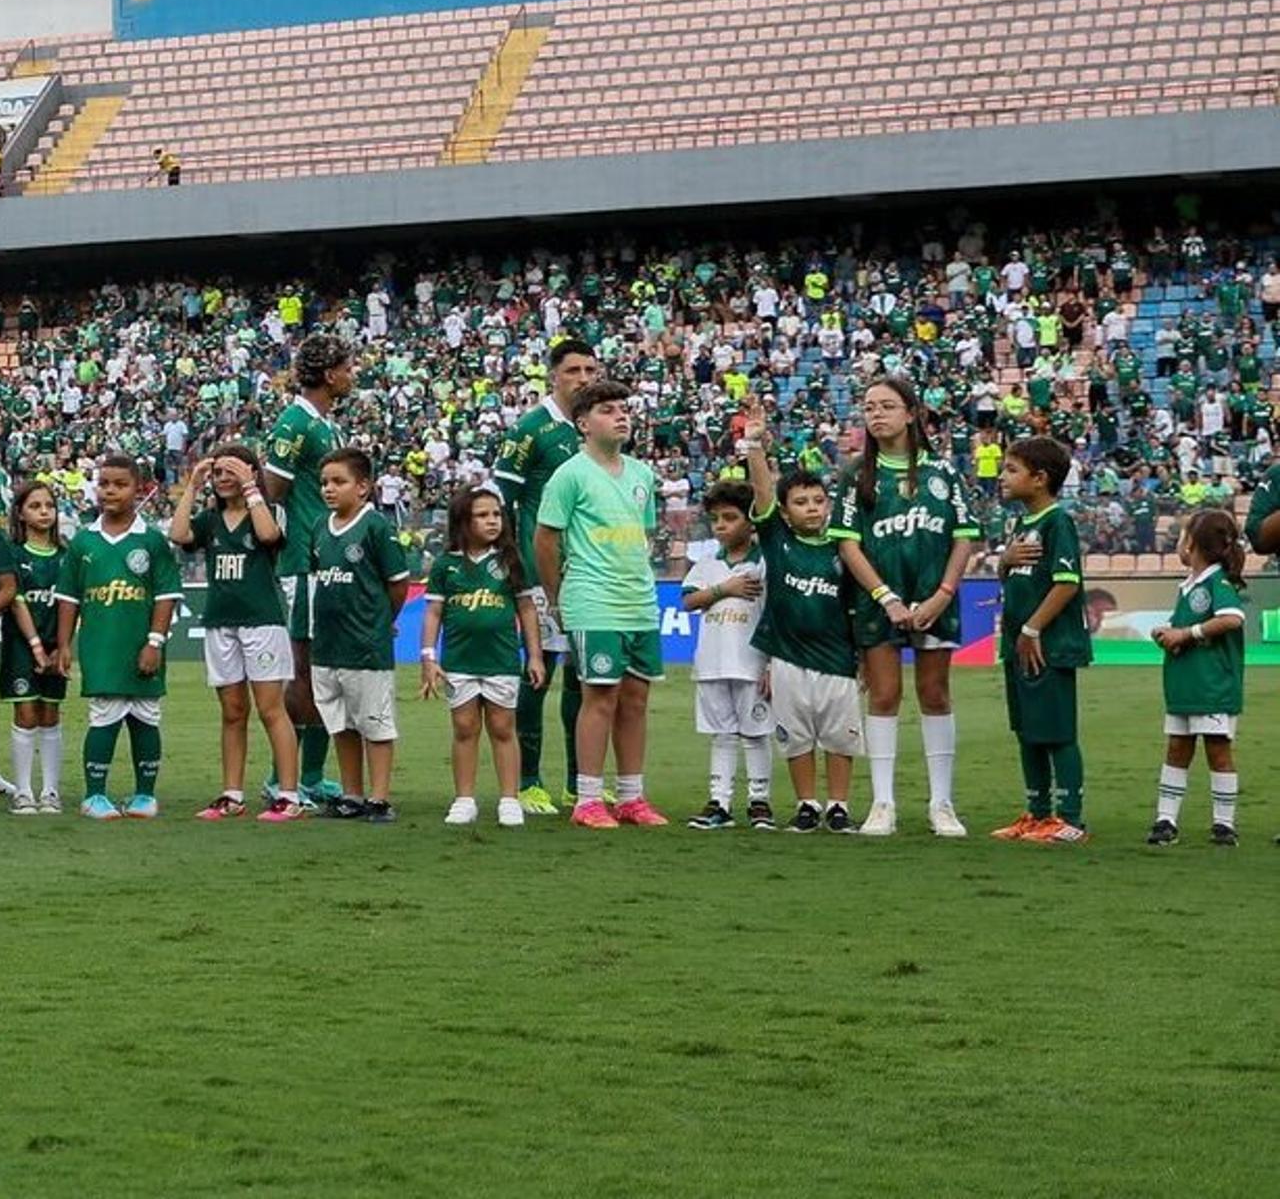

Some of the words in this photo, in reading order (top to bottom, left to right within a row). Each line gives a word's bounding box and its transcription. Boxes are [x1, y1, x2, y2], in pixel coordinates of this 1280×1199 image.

[872, 505, 946, 538] crefisa
[215, 554, 246, 580] FIAT
[315, 566, 354, 586] refisa
[25, 585, 56, 607] cref
[784, 573, 839, 598] crefisa
